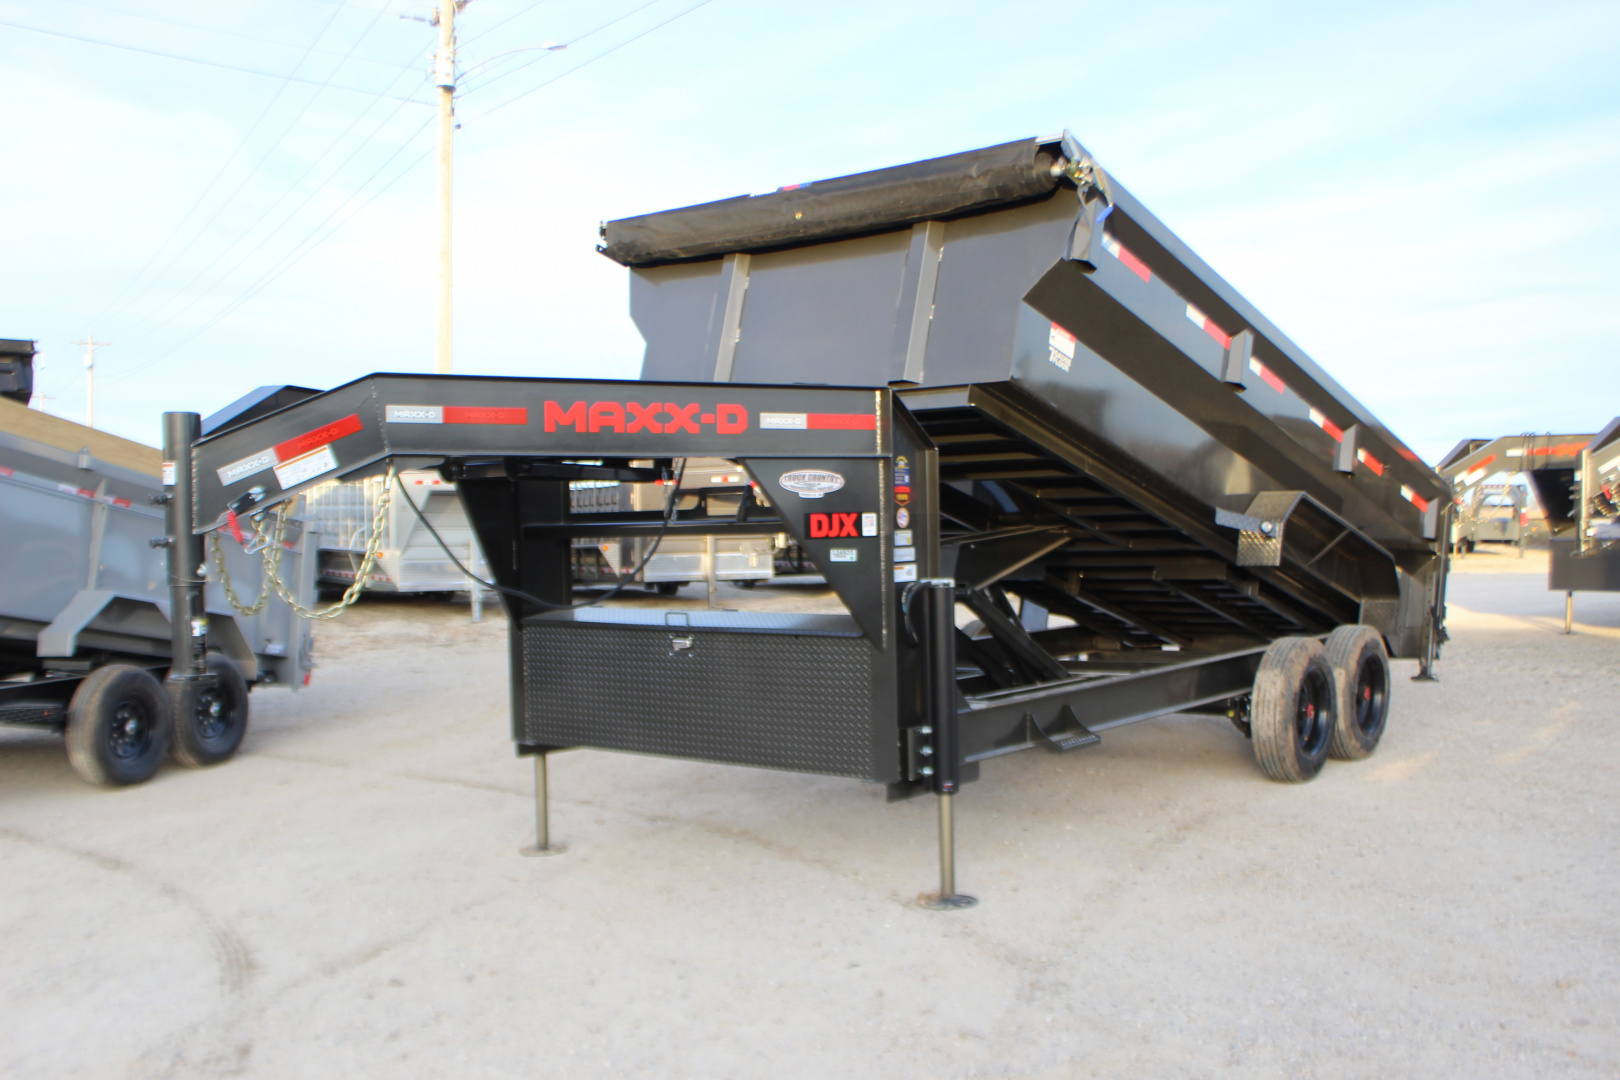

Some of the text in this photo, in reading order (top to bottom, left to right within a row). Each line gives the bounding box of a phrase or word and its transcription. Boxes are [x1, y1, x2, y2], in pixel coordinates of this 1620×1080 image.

[393, 410, 436, 419] MAXX-D
[543, 400, 748, 434] MAXX-D
[766, 416, 801, 425] MAXX-D
[296, 427, 343, 449] MAXX-D
[226, 455, 270, 478] MAXX-D
[783, 473, 839, 484] TRUCK COUNTRY
[809, 511, 860, 538] DJX
